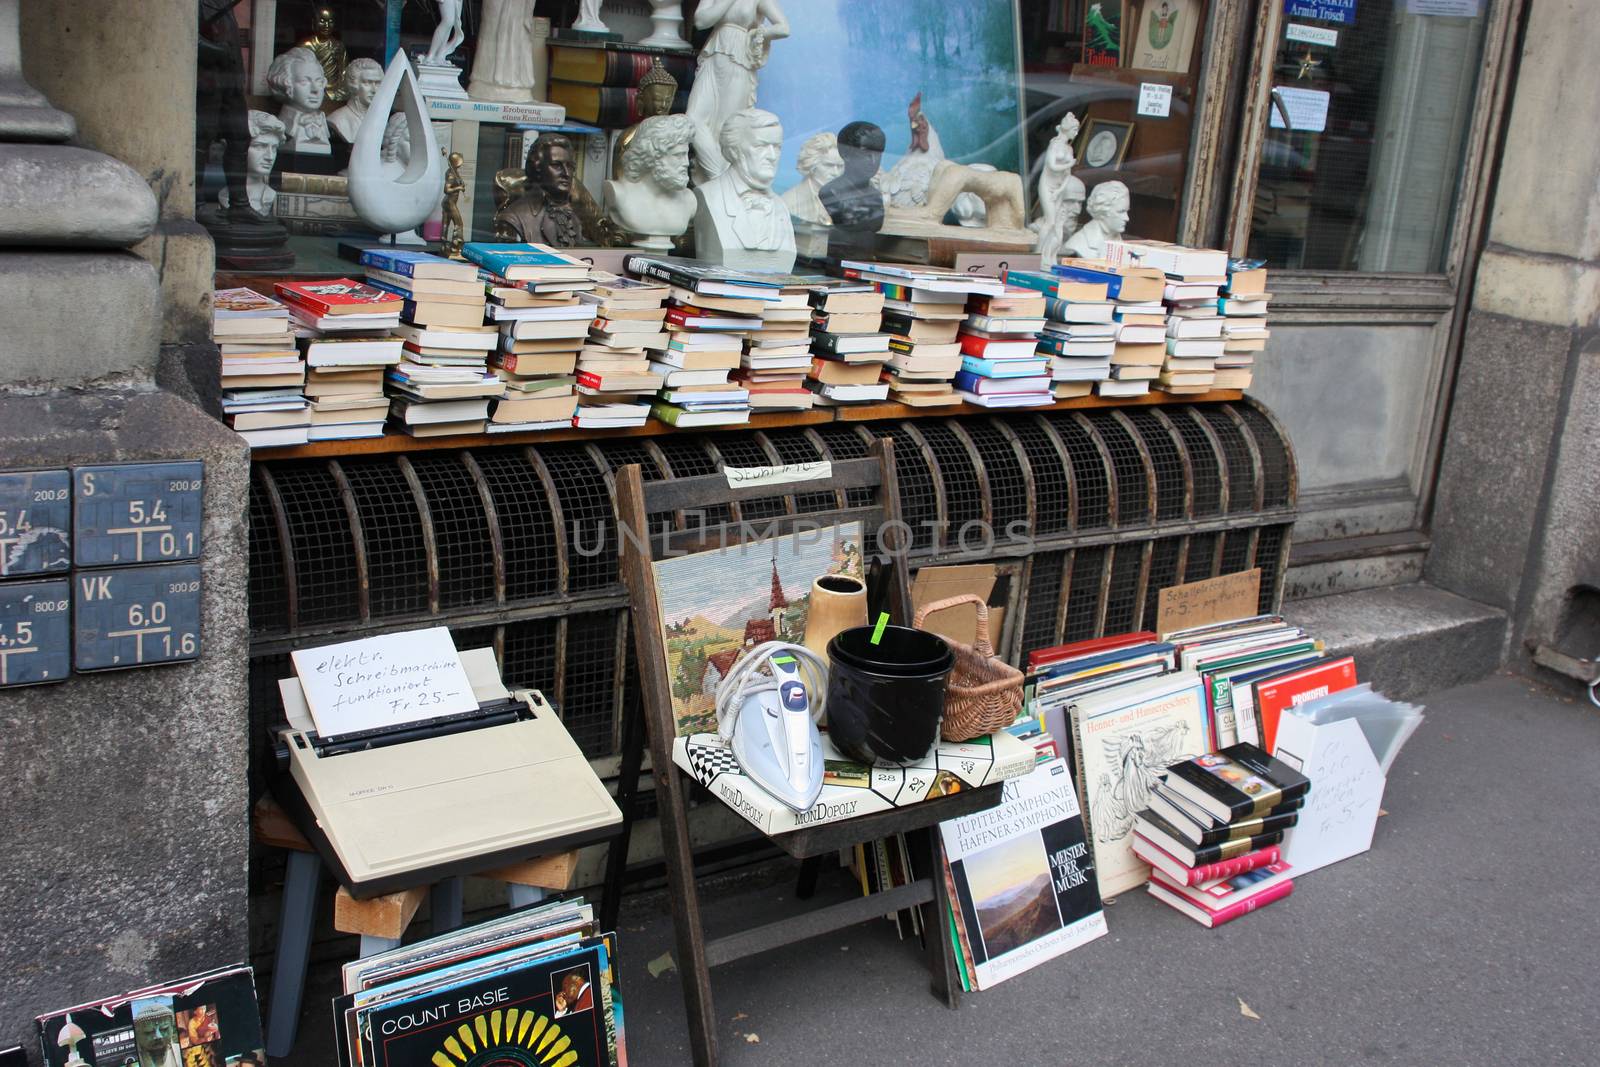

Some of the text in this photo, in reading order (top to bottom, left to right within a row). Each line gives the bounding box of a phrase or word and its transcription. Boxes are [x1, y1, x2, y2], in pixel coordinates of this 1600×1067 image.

[431, 101, 462, 110] Atlantis
[473, 103, 499, 113] Mittler
[502, 106, 541, 115] Eroberung
[83, 473, 95, 497] S
[82, 576, 113, 601] VK
[877, 774, 895, 782] 28
[909, 777, 925, 794] 27
[956, 783, 1072, 839] JUPITER-SYMPHONIE
[959, 801, 1077, 853] HAFFNER-SYMPHONIE
[1049, 842, 1088, 868] MEISTER
[1059, 859, 1080, 878] DER
[1056, 870, 1088, 894] MUSIK
[382, 1003, 450, 1036] COUNT
[458, 987, 510, 1014] BASIE
